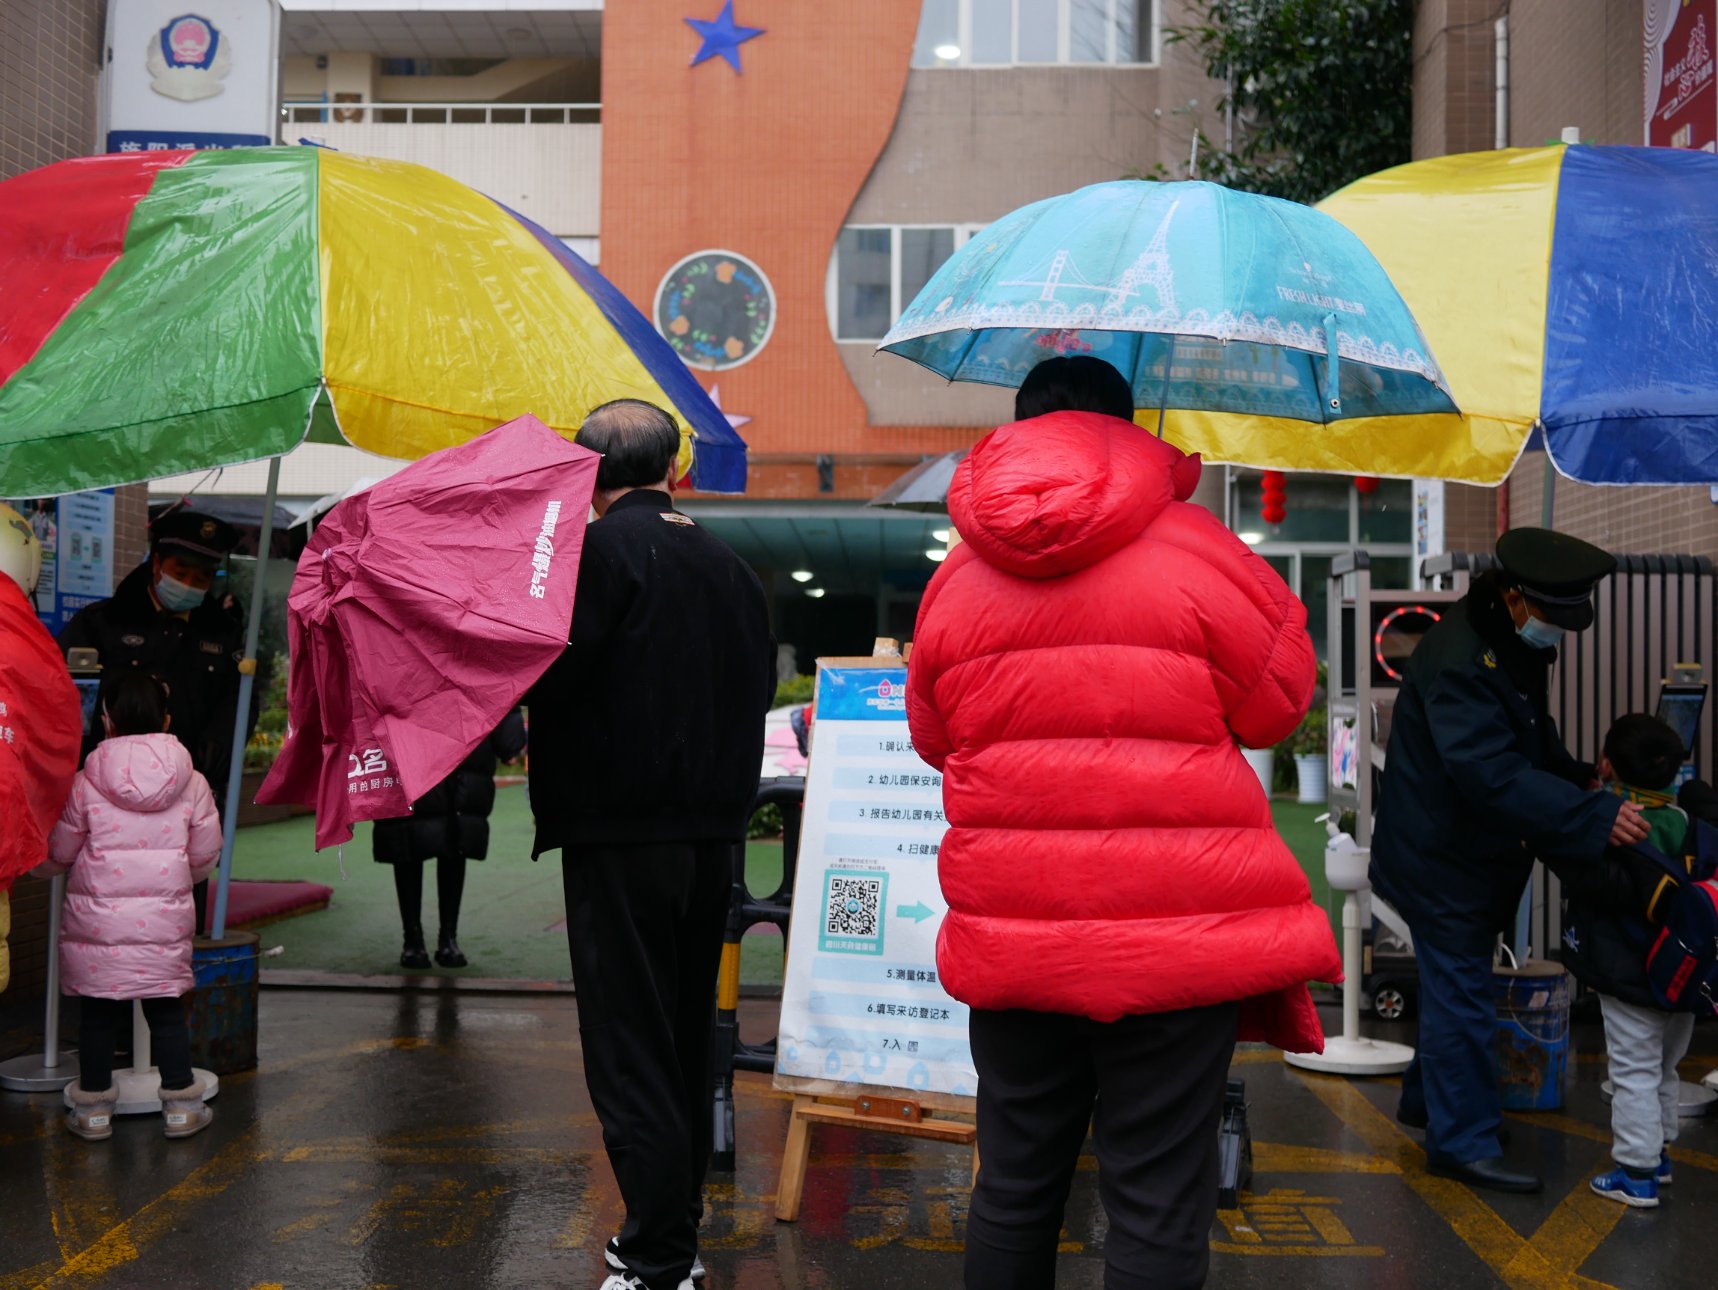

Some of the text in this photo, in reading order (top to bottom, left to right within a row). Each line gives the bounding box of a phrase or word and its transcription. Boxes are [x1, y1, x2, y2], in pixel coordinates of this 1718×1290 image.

[348, 776, 402, 794] 用的厨房
[886, 969, 936, 983] 5.测量体温
[867, 1003, 950, 1020] 6.填写来访登记本
